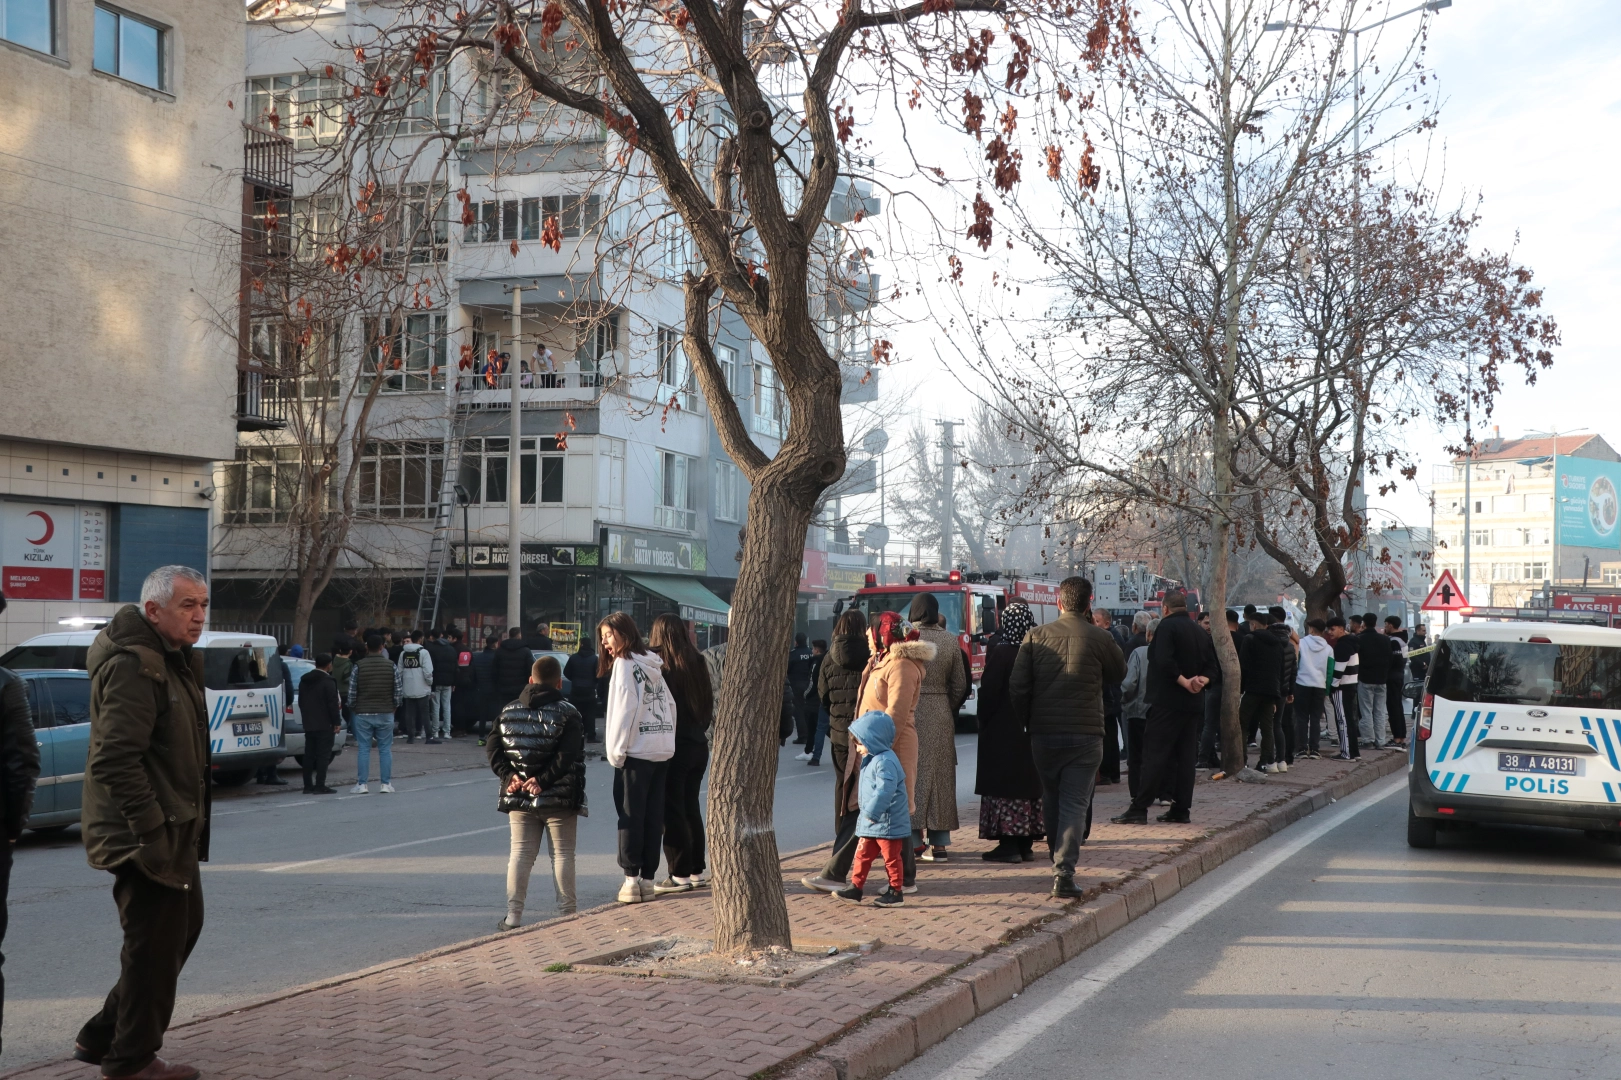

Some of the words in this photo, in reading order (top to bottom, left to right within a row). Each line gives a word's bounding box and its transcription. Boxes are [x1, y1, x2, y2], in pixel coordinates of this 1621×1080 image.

[492, 553, 509, 564] HATA
[519, 551, 550, 564] ÖRESEL
[635, 548, 651, 566] HATAY
[652, 547, 676, 567] YÖRESEL
[1563, 602, 1613, 613] KAYSERİ
[1505, 755, 1519, 767] 38
[1528, 756, 1536, 769] A
[1540, 757, 1573, 771] 48131
